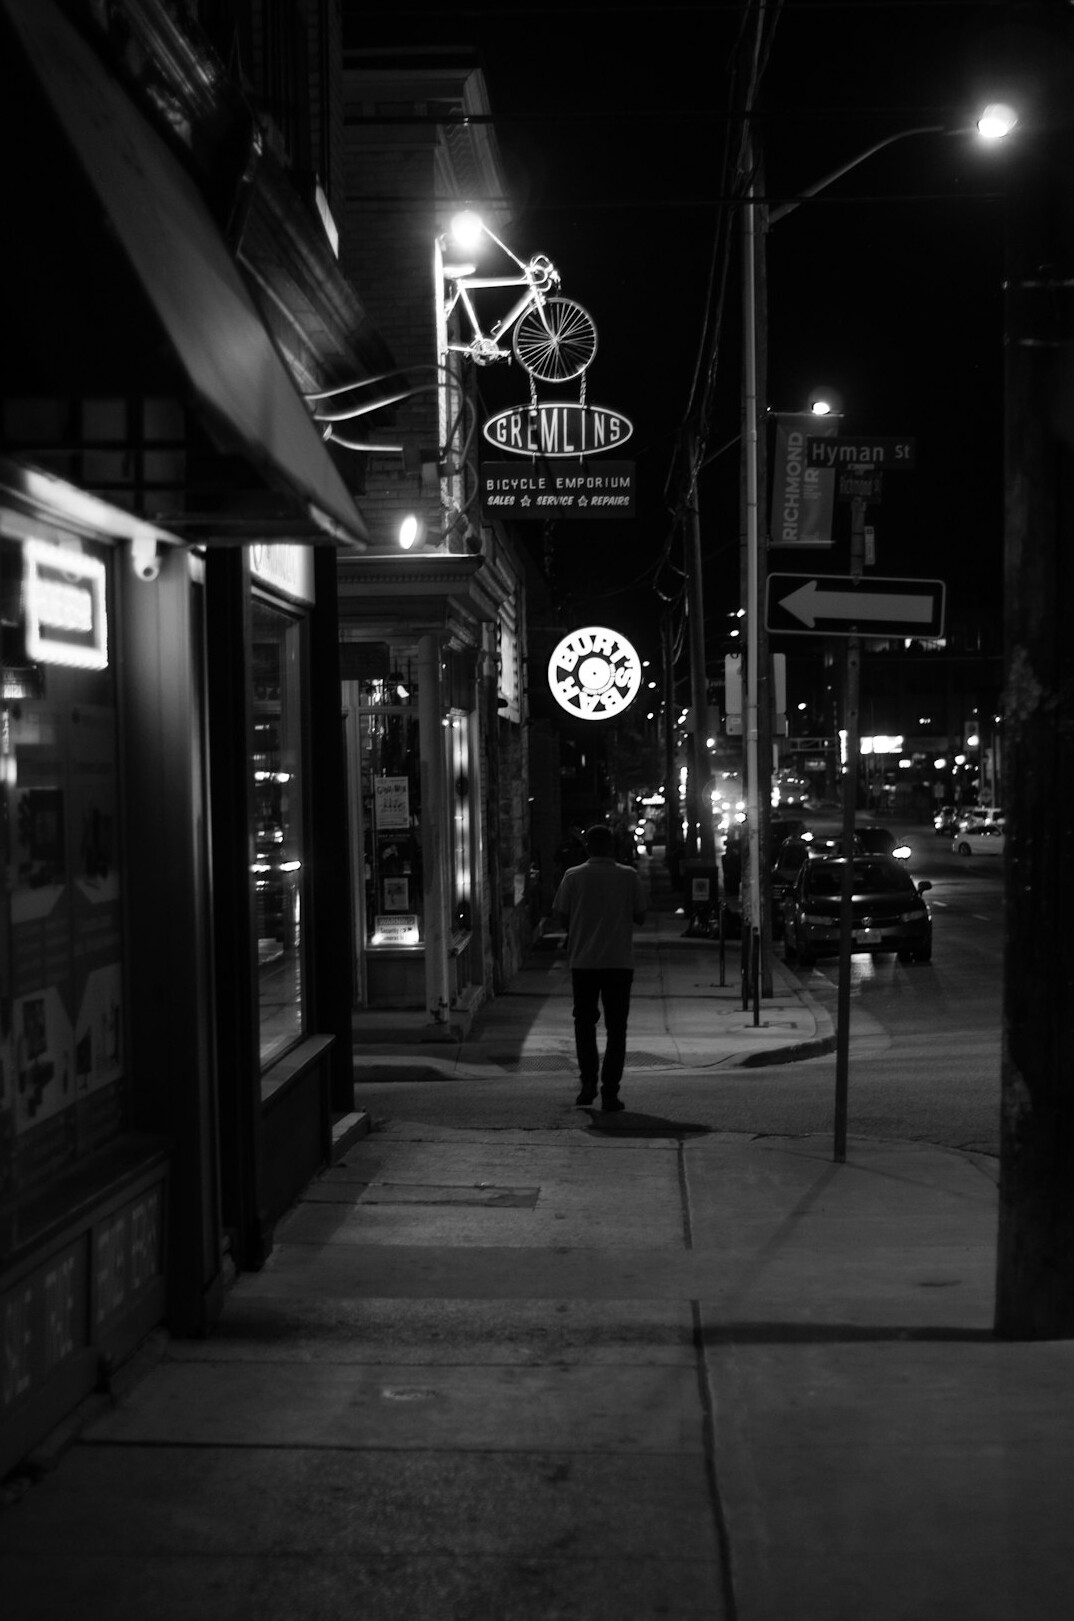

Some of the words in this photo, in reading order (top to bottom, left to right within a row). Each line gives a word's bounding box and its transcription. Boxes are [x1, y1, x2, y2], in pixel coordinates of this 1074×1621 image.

[496, 407, 621, 453] GREMLINS
[812, 443, 884, 466] Hyman
[895, 444, 910, 460] St
[486, 477, 547, 490] BICYCLE
[555, 476, 632, 490] EMPORIUM
[486, 495, 516, 506] SALES
[535, 495, 574, 506] SERVICE
[590, 495, 631, 506] REPAIRS
[782, 432, 803, 541] RICHMOND
[556, 634, 634, 688] BURT'S
[557, 675, 625, 713] BAR
